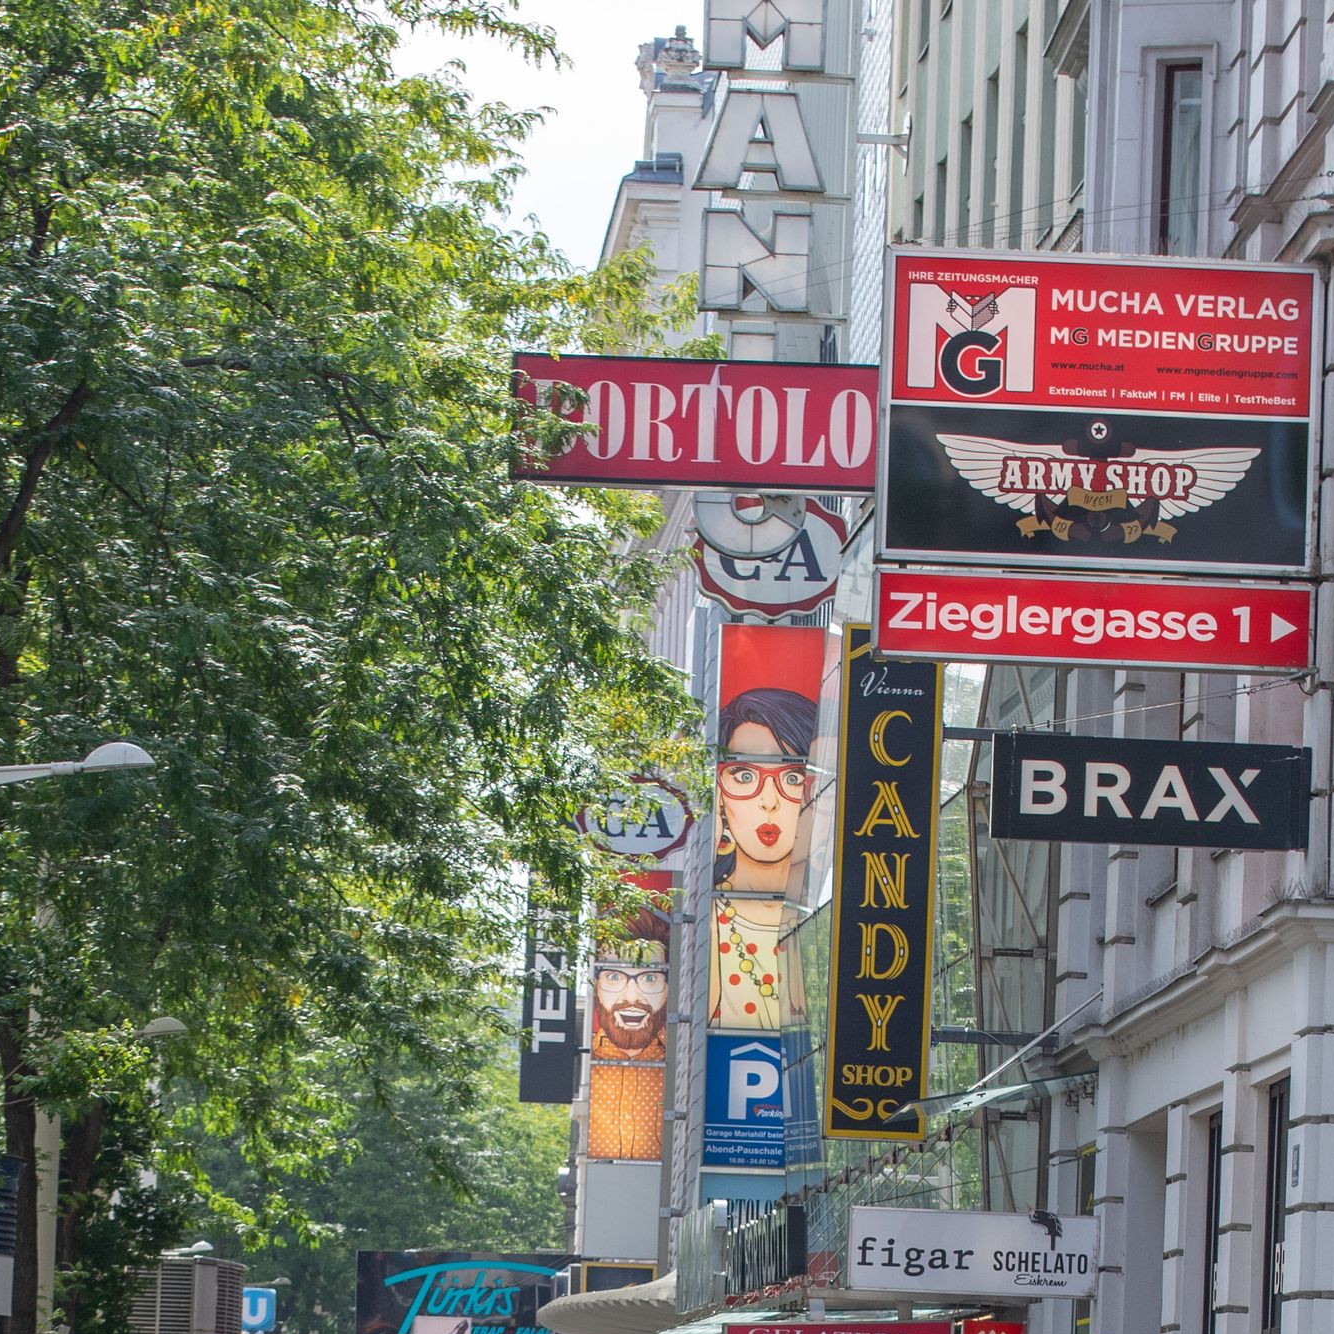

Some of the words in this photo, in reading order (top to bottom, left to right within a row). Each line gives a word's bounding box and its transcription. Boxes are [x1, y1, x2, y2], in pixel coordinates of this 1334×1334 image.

[692, 0, 827, 559] MANC
[908, 270, 934, 281] IHRE
[937, 271, 1039, 285] ZEITUNGSMACHER
[1051, 288, 1164, 316] MUCHA
[1175, 293, 1300, 321] VERLAG
[1050, 326, 1088, 345] MG
[1097, 328, 1299, 356] MEDIENGRUPPE
[1050, 360, 1125, 373] www.mucha.at
[1156, 365, 1298, 381] www.mgmediengruppe.com
[1049, 385, 1107, 398] ExtraDienst
[1120, 389, 1157, 401] FaktuM
[1170, 391, 1185, 402] FM
[1198, 392, 1221, 404] Elite
[1234, 394, 1296, 406] TestTheBest
[1003, 458, 1098, 493] ARMY
[1105, 462, 1196, 499] SHOP
[888, 591, 1218, 645] Zieglergasse
[1232, 605, 1251, 643] 1
[860, 668, 925, 698] Vienna
[1019, 758, 1262, 826] BRAX
[853, 708, 921, 1053] CANDY
[728, 1059, 780, 1120] P
[842, 1064, 914, 1089] SHOP
[706, 1128, 731, 1139] Garage
[734, 1129, 766, 1140] Mariahilf
[705, 1144, 783, 1156] Abend-Pauschale
[857, 1237, 974, 1277] figar
[993, 1250, 1088, 1275] SCHELATO
[1014, 1273, 1067, 1287] Eiskrem
[242, 1297, 267, 1325] U
